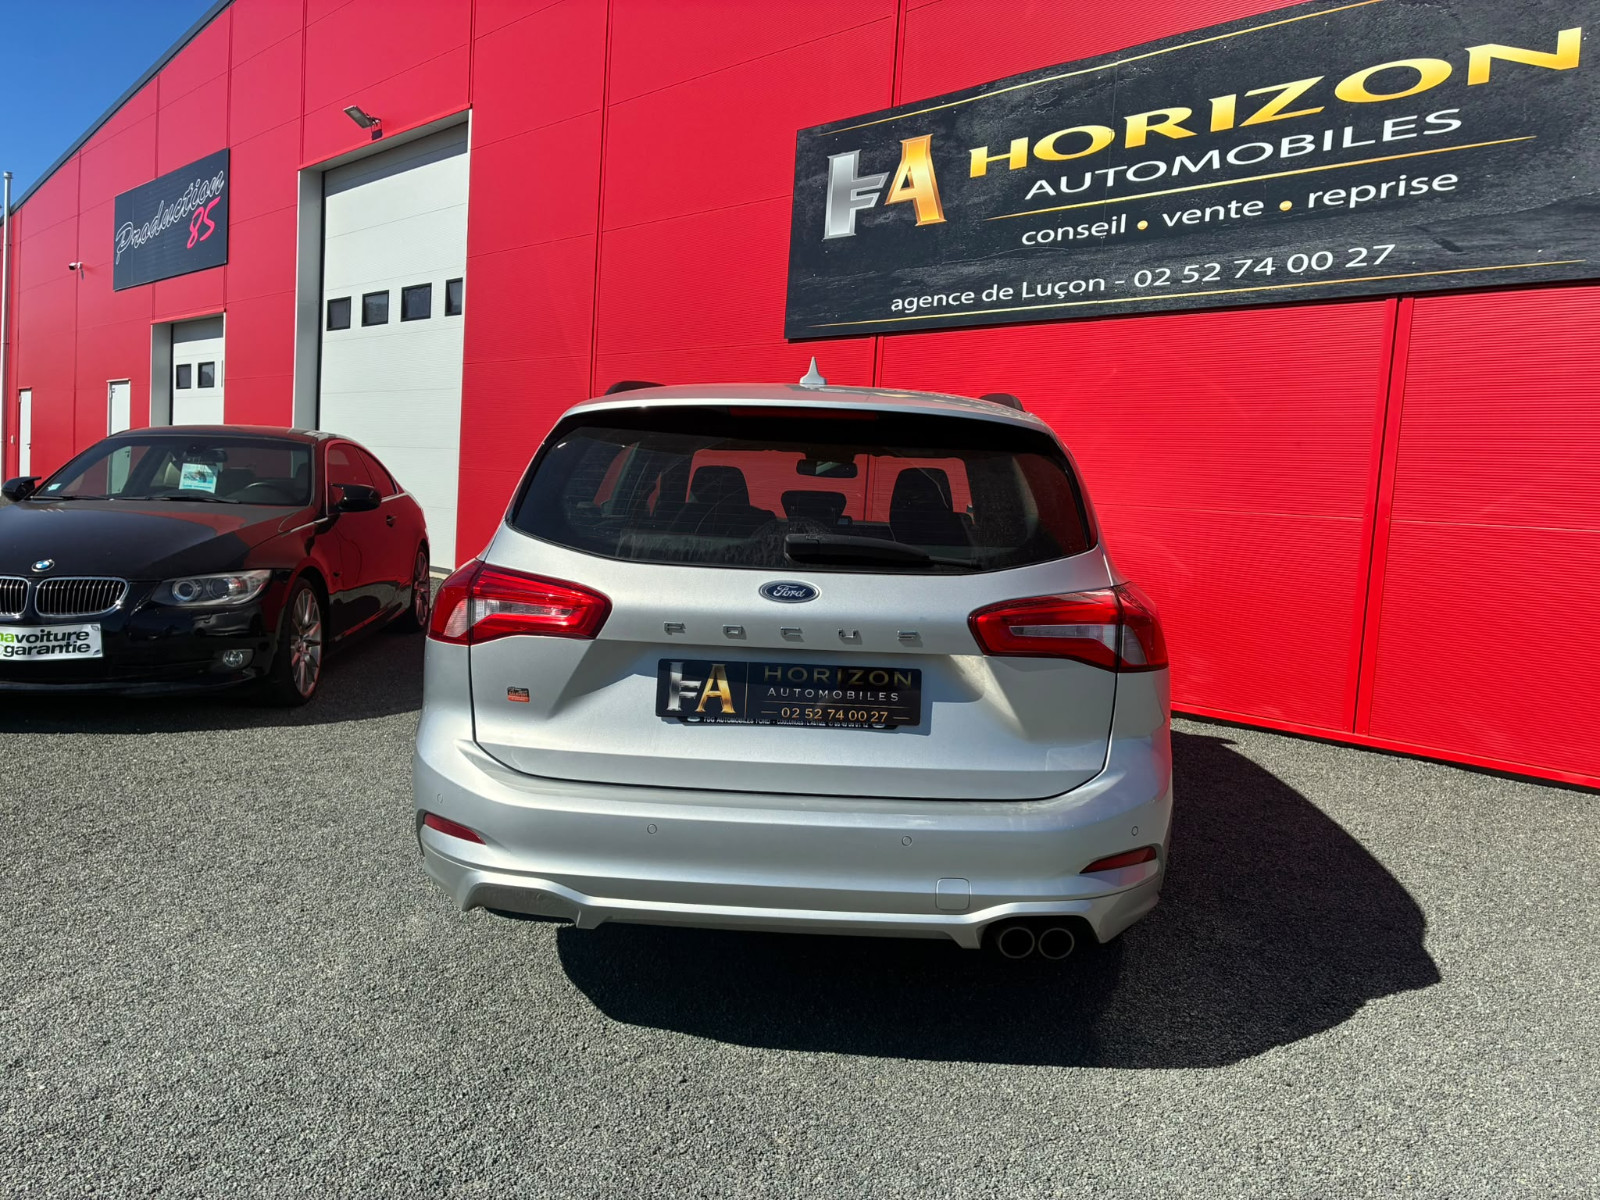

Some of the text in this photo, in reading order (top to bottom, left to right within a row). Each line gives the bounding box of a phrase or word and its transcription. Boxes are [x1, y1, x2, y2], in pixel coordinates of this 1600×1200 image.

[969, 27, 1582, 178] HORIZON
[1025, 108, 1462, 200] AUTOMOBILES
[115, 170, 224, 265] Production
[187, 196, 221, 249] 85
[1021, 174, 1458, 245] conseil vente reprise
[891, 289, 974, 313] agence
[982, 284, 1013, 302] de
[1022, 277, 1105, 300] Luçon
[1134, 268, 1170, 288] 02
[1181, 263, 1221, 283] 52
[1234, 257, 1275, 278] 74
[1286, 251, 1333, 273] 00
[1345, 244, 1396, 268] 27
[773, 584, 806, 598] Ford
[664, 620, 917, 641] FOCUS
[3, 641, 91, 658] garantie
[764, 665, 912, 687] HORIZON
[767, 687, 899, 701] AUTOMOBILES
[781, 707, 888, 723] 02 52 74 00 27
